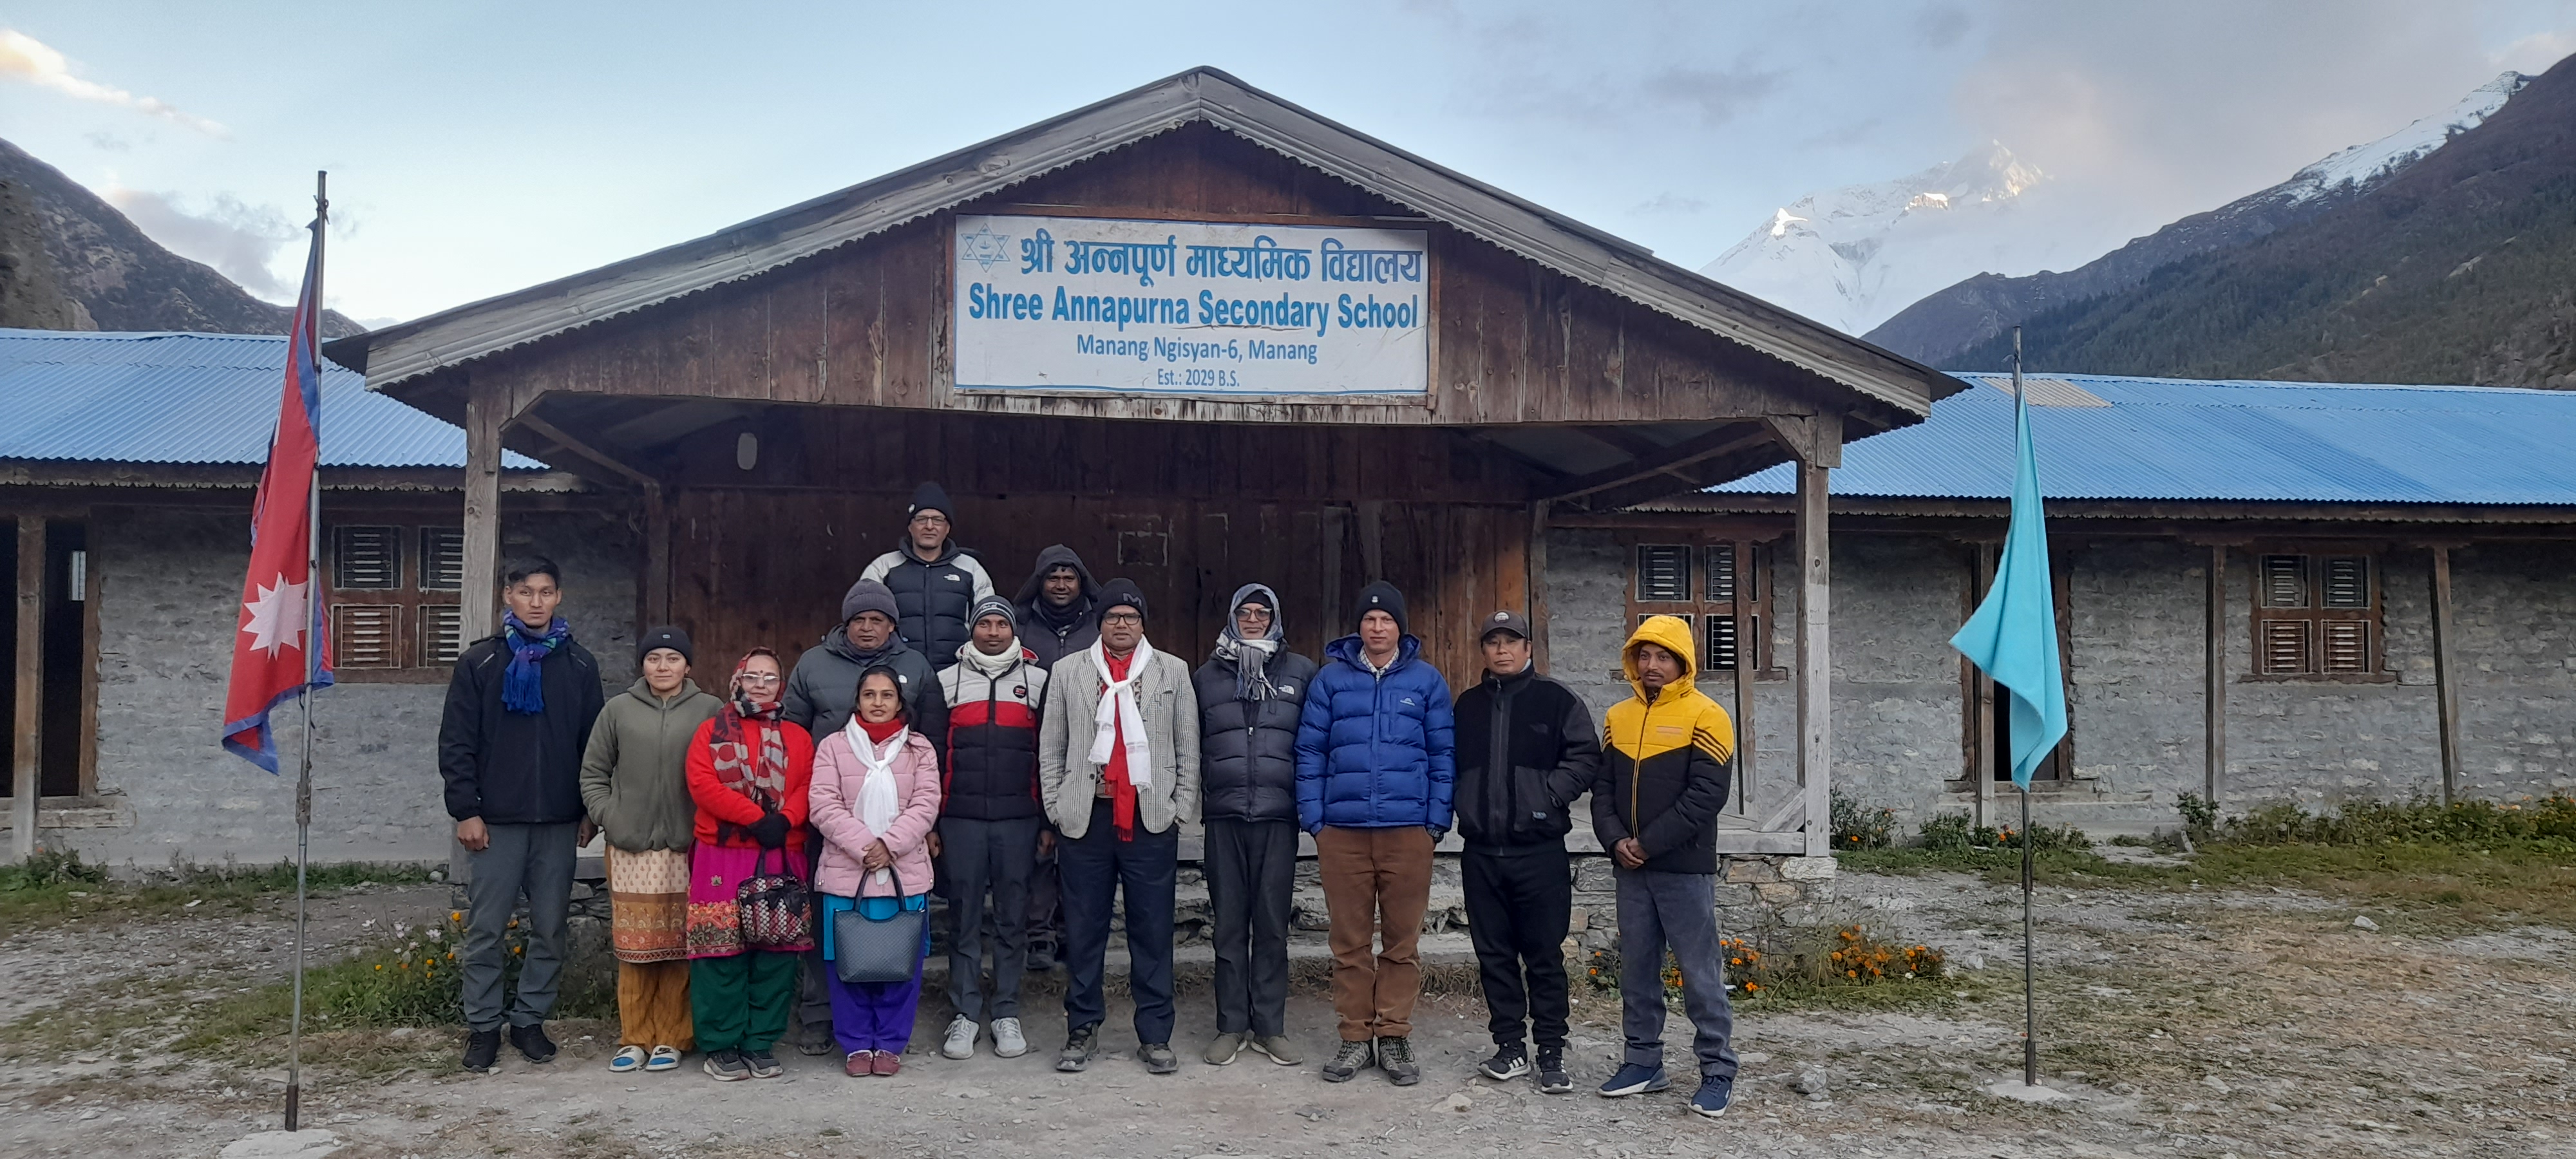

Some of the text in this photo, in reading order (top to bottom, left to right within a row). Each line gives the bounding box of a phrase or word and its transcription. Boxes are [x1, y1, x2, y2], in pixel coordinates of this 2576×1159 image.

[1021, 228, 1423, 288] श्री अन्नपूर्ण माध्यमिक विद्यालय
[969, 283, 1417, 337] Shree Annapurna Secondary School
[1077, 335, 1318, 364] Manang Ngisyan-6, Manang
[1158, 369, 1240, 387] Est.: 2029 B.S.
